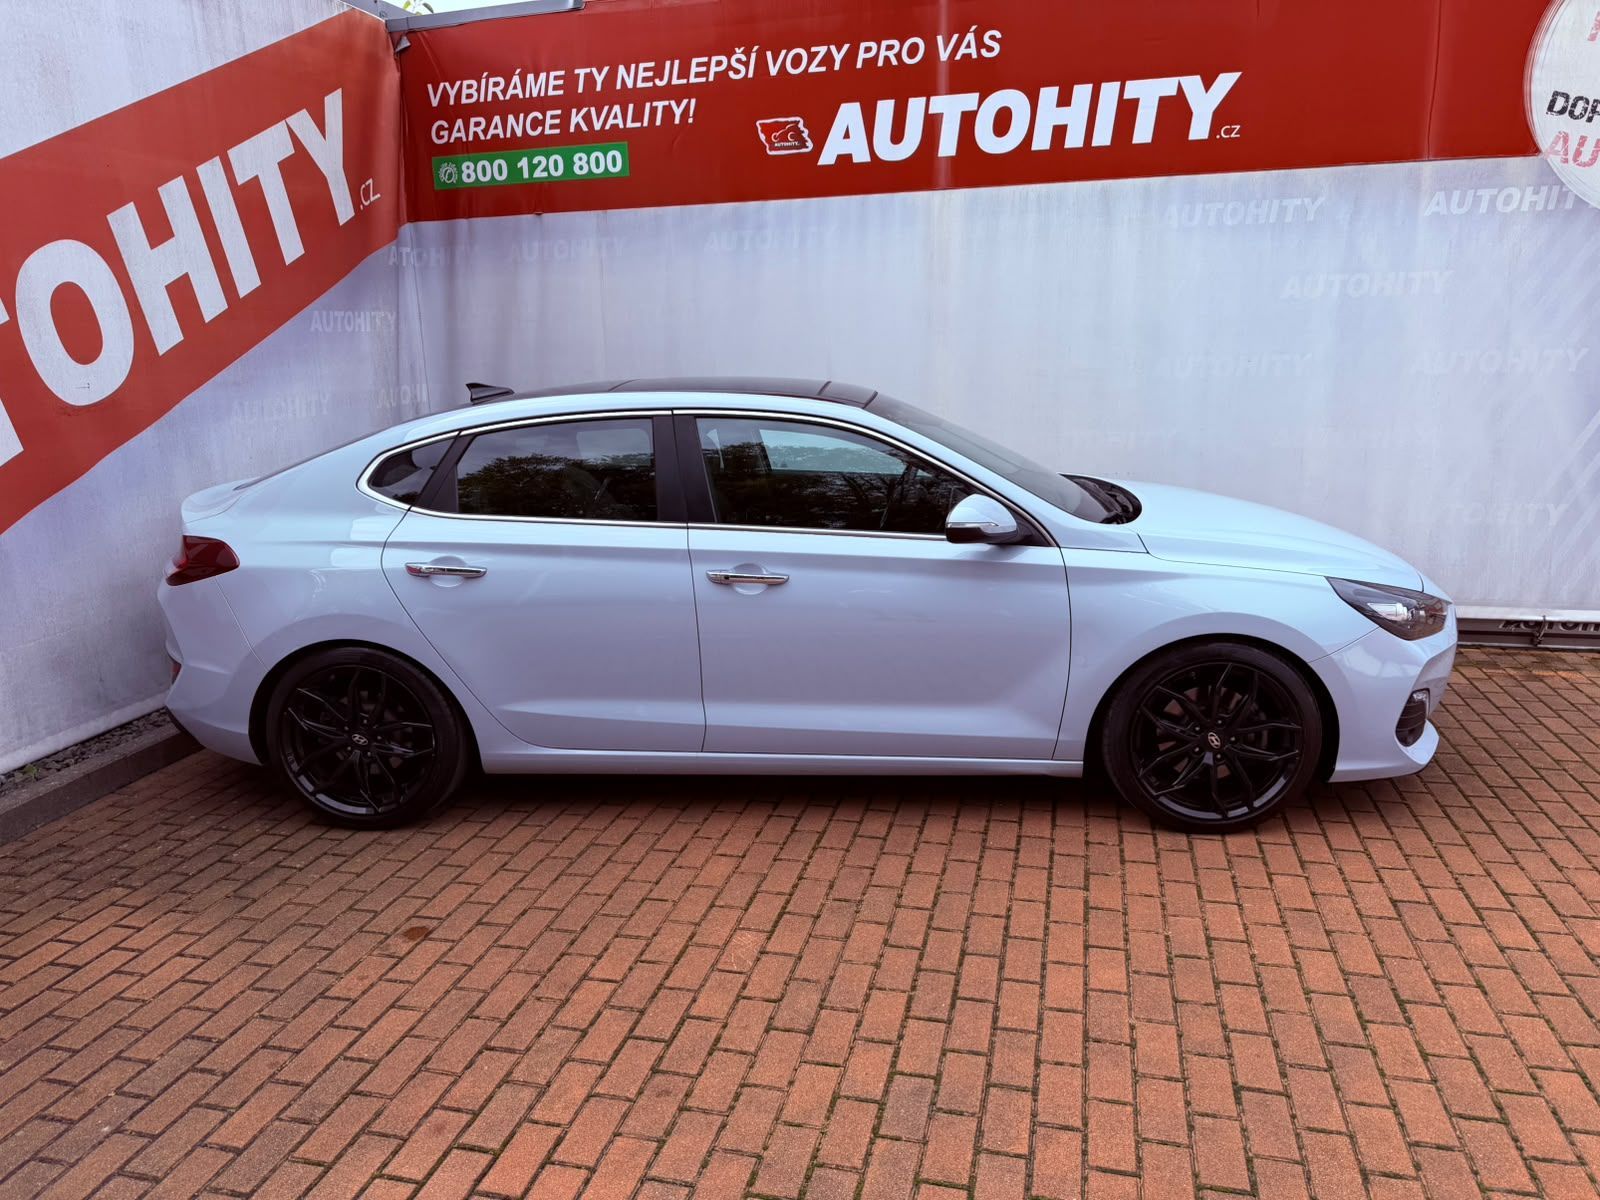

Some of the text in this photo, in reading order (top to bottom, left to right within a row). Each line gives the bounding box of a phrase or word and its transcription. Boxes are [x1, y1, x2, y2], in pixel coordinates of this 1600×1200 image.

[427, 25, 1003, 107] VYBÍRÁME TY NEJLEPŠÍ VOZY PRO VÁS
[431, 98, 696, 144] GARANCE KVALITY!
[817, 71, 1243, 165] AUTOHITY
[461, 158, 508, 183] 800
[517, 153, 564, 179] 120
[573, 149, 623, 176] 800
[1162, 196, 1325, 229] AUTOHITY
[1423, 185, 1594, 217] AUTOHIT
[1280, 269, 1454, 301] AUTOHITY
